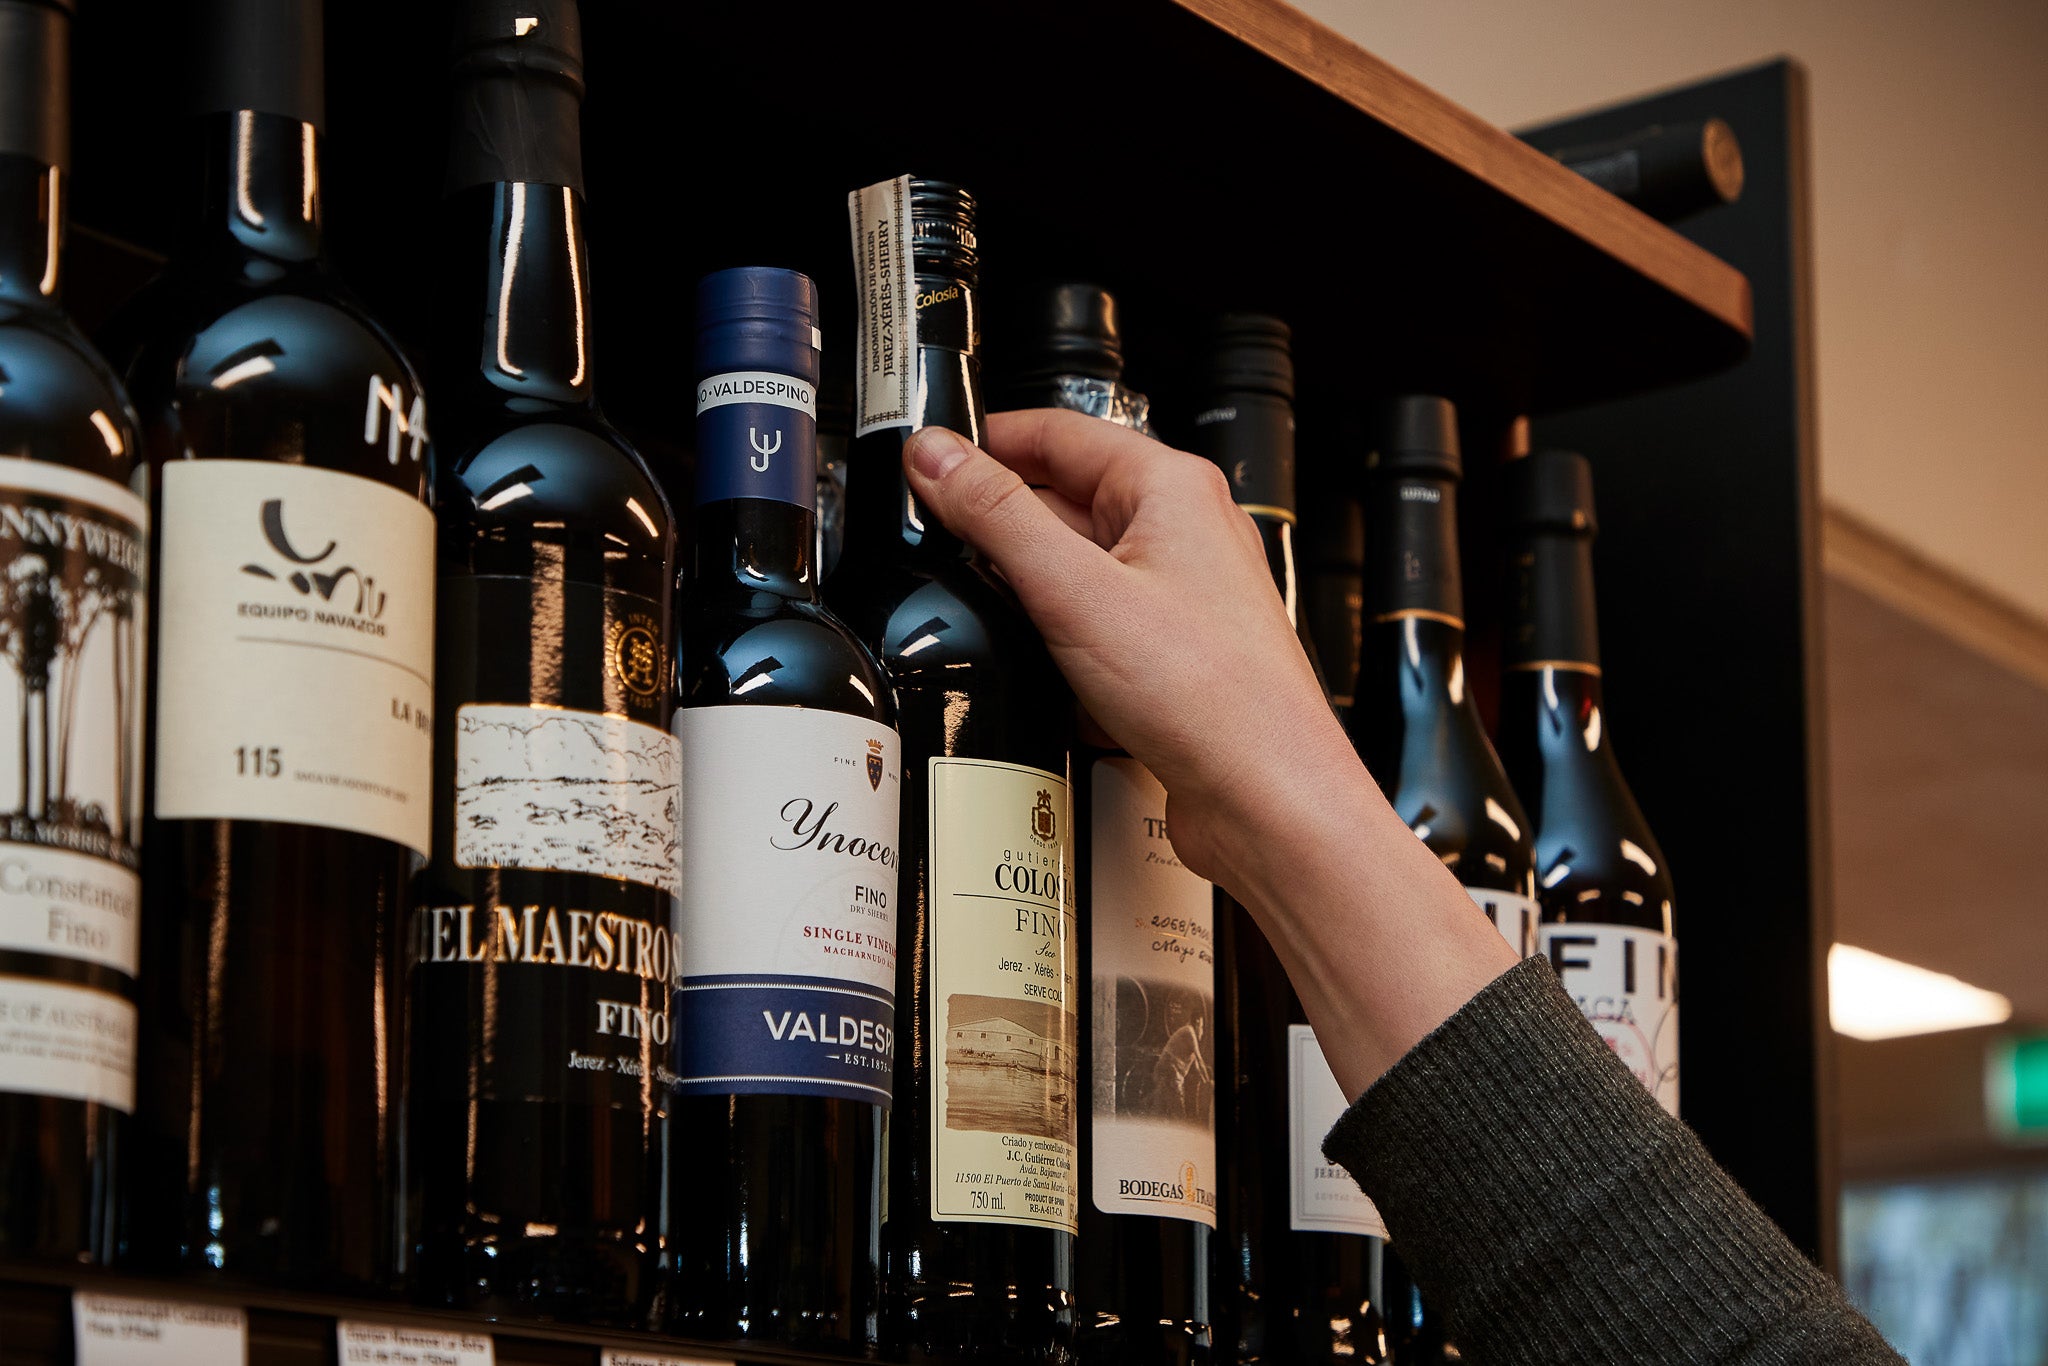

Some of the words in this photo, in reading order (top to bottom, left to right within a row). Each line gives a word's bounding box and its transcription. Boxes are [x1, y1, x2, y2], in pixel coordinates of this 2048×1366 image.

[867, 230, 876, 271] ORIGEN
[869, 271, 877, 287] DE
[869, 288, 880, 373] DENOMINACIÓN
[713, 380, 809, 404] VALDESPINO
[237, 603, 310, 622] EQUIPO
[314, 611, 387, 637] NAVAZOS
[391, 697, 411, 722] LA
[234, 746, 282, 778] 115
[834, 757, 857, 767] FINE
[855, 885, 887, 909] FINO
[850, 904, 865, 915] DRY
[494, 904, 670, 983] MAESTRO
[803, 925, 862, 945] SINGLE
[823, 945, 886, 965] MACHARNUDO
[1035, 941, 1056, 958] Seco
[998, 957, 1023, 972] Jerez
[1034, 962, 1054, 978] Xérès
[1024, 983, 1047, 998] SERVE
[596, 1000, 669, 1045] FINO
[568, 1050, 606, 1071] Jerez
[1001, 1135, 1027, 1148] Criado
[1028, 1140, 1034, 1150] y
[1006, 1150, 1023, 1162] J.C.
[1024, 1151, 1055, 1167] Gutiérrez
[1019, 1164, 1038, 1175] Avda.
[955, 1172, 982, 1183] 11500
[983, 1174, 993, 1184] El
[995, 1174, 1022, 1187] Puerto
[1022, 1177, 1031, 1188] de
[1032, 1178, 1050, 1190] Santa
[1119, 1179, 1184, 1200] BODEGAS
[971, 1191, 989, 1208] 750
[991, 1192, 1006, 1210] ml.
[1024, 1193, 1048, 1204] PRODUCT
[1048, 1196, 1054, 1204] OF
